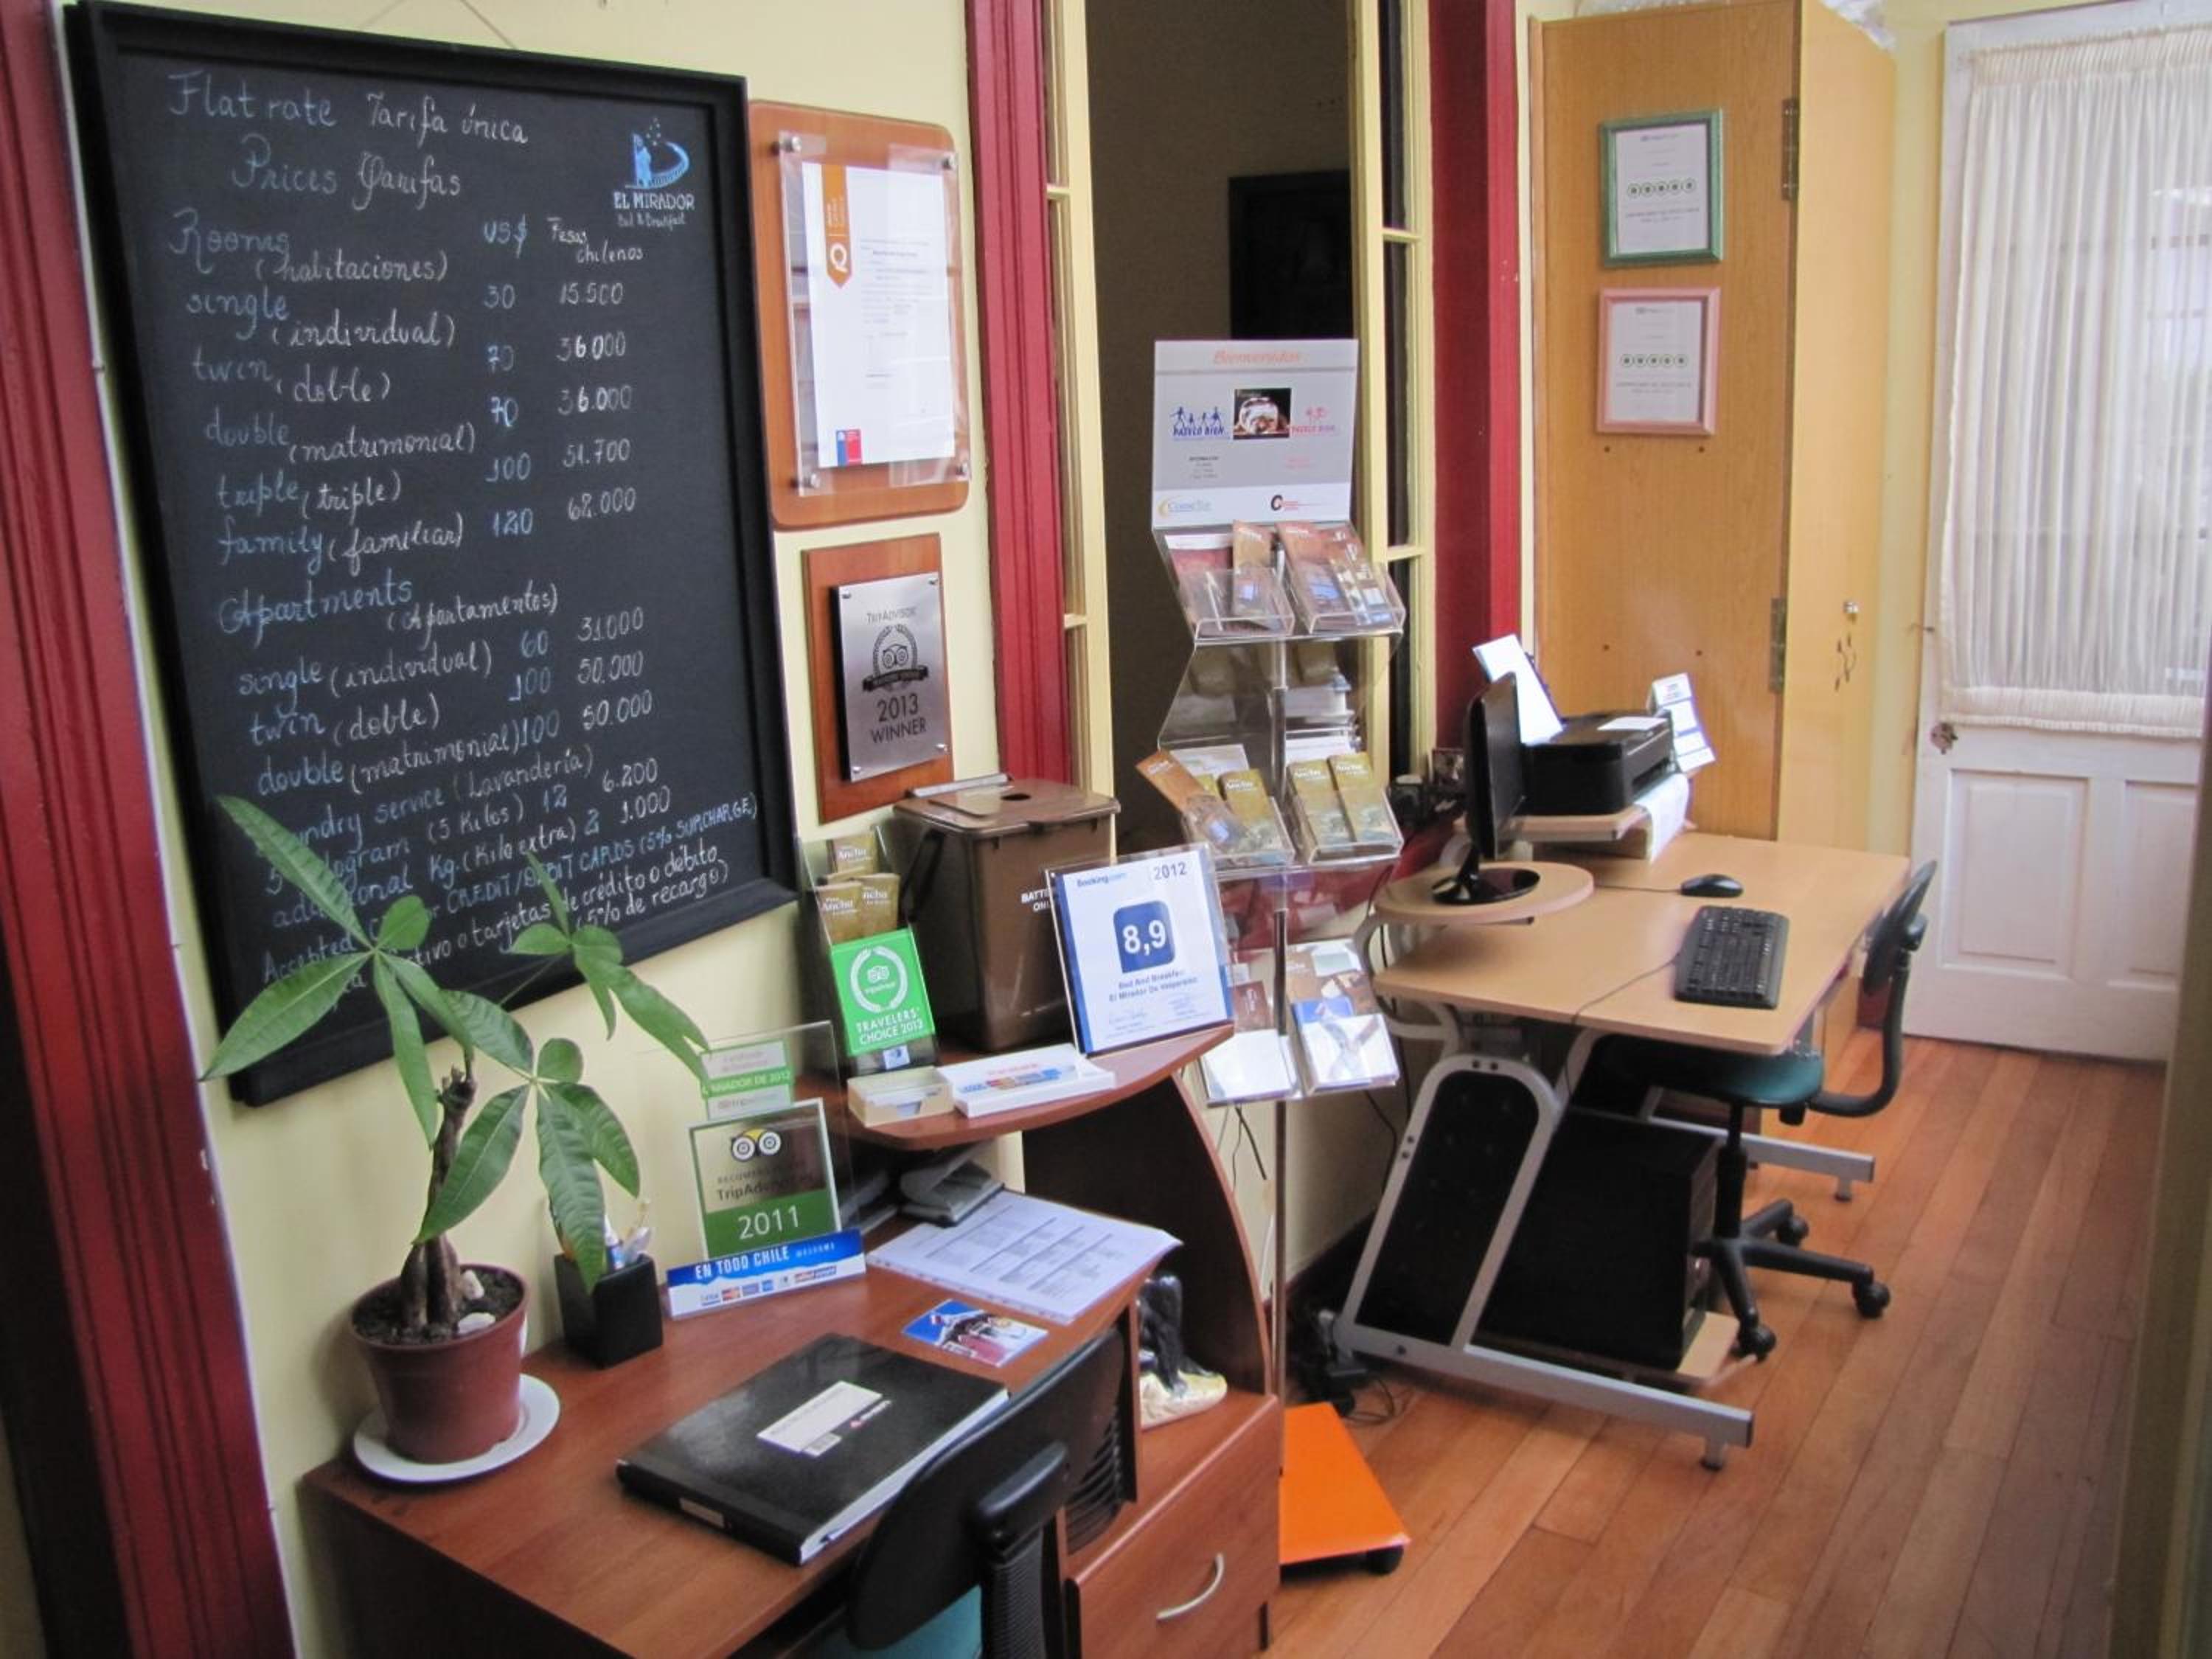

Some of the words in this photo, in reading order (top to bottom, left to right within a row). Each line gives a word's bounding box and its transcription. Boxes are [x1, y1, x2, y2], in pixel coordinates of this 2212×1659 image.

[169, 70, 256, 116] Flat
[267, 87, 336, 127] rate
[366, 92, 448, 147] Tarifa
[231, 133, 338, 193] Prices
[613, 191, 630, 209] EL
[633, 192, 695, 210] MIRADOR
[186, 285, 290, 341] single
[484, 283, 515, 310] 30
[204, 406, 290, 446] double
[219, 515, 322, 575] family
[239, 655, 323, 717] single
[521, 630, 549, 658] 60
[877, 692, 920, 723] 2013
[870, 717, 928, 745] WINNER
[258, 748, 344, 796] double
[1152, 861, 1189, 881] 2012
[1122, 919, 1167, 956] 8,9
[860, 1025, 900, 1044] CHOICE
[738, 1205, 799, 1240] 2011
[695, 1262, 713, 1280] EN
[717, 1254, 749, 1276] TODO
[753, 1245, 790, 1267] CHILE
